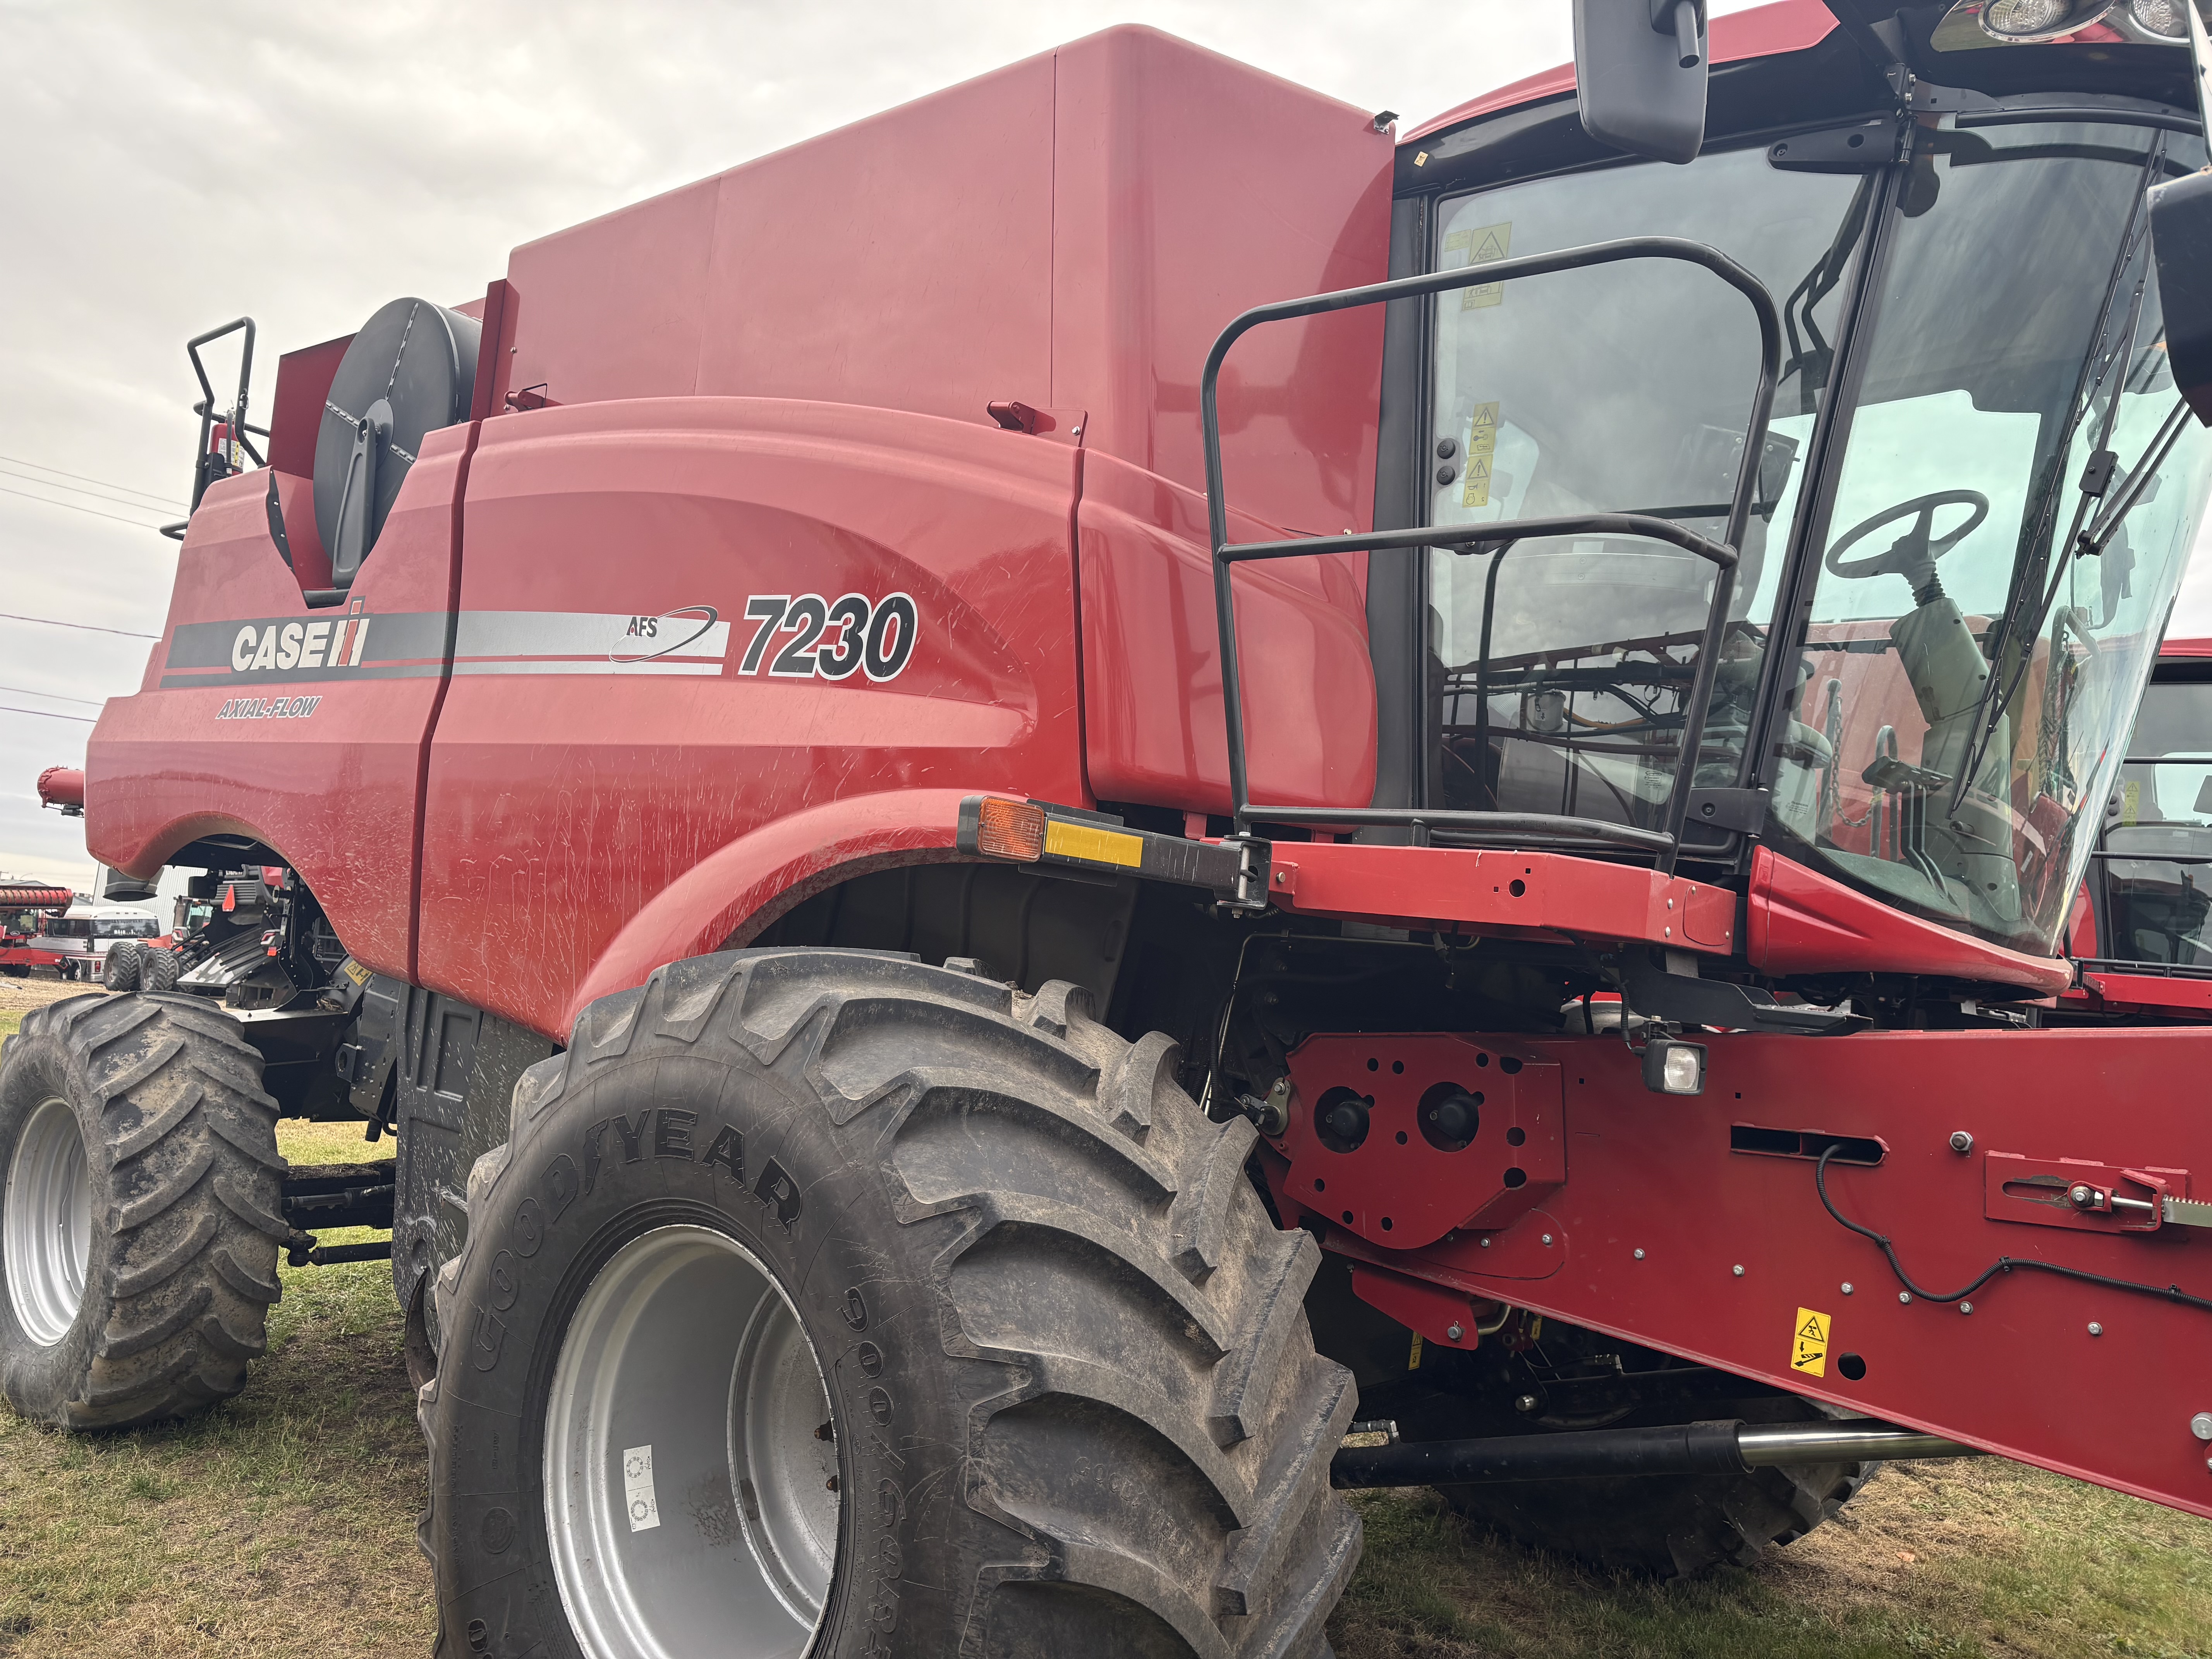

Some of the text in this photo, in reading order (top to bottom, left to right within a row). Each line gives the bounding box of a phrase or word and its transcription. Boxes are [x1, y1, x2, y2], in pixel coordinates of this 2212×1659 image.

[627, 616, 658, 638] AFS
[737, 592, 918, 682] 7230
[232, 622, 331, 672] CASE
[215, 696, 323, 720] AXIAL-FLOW
